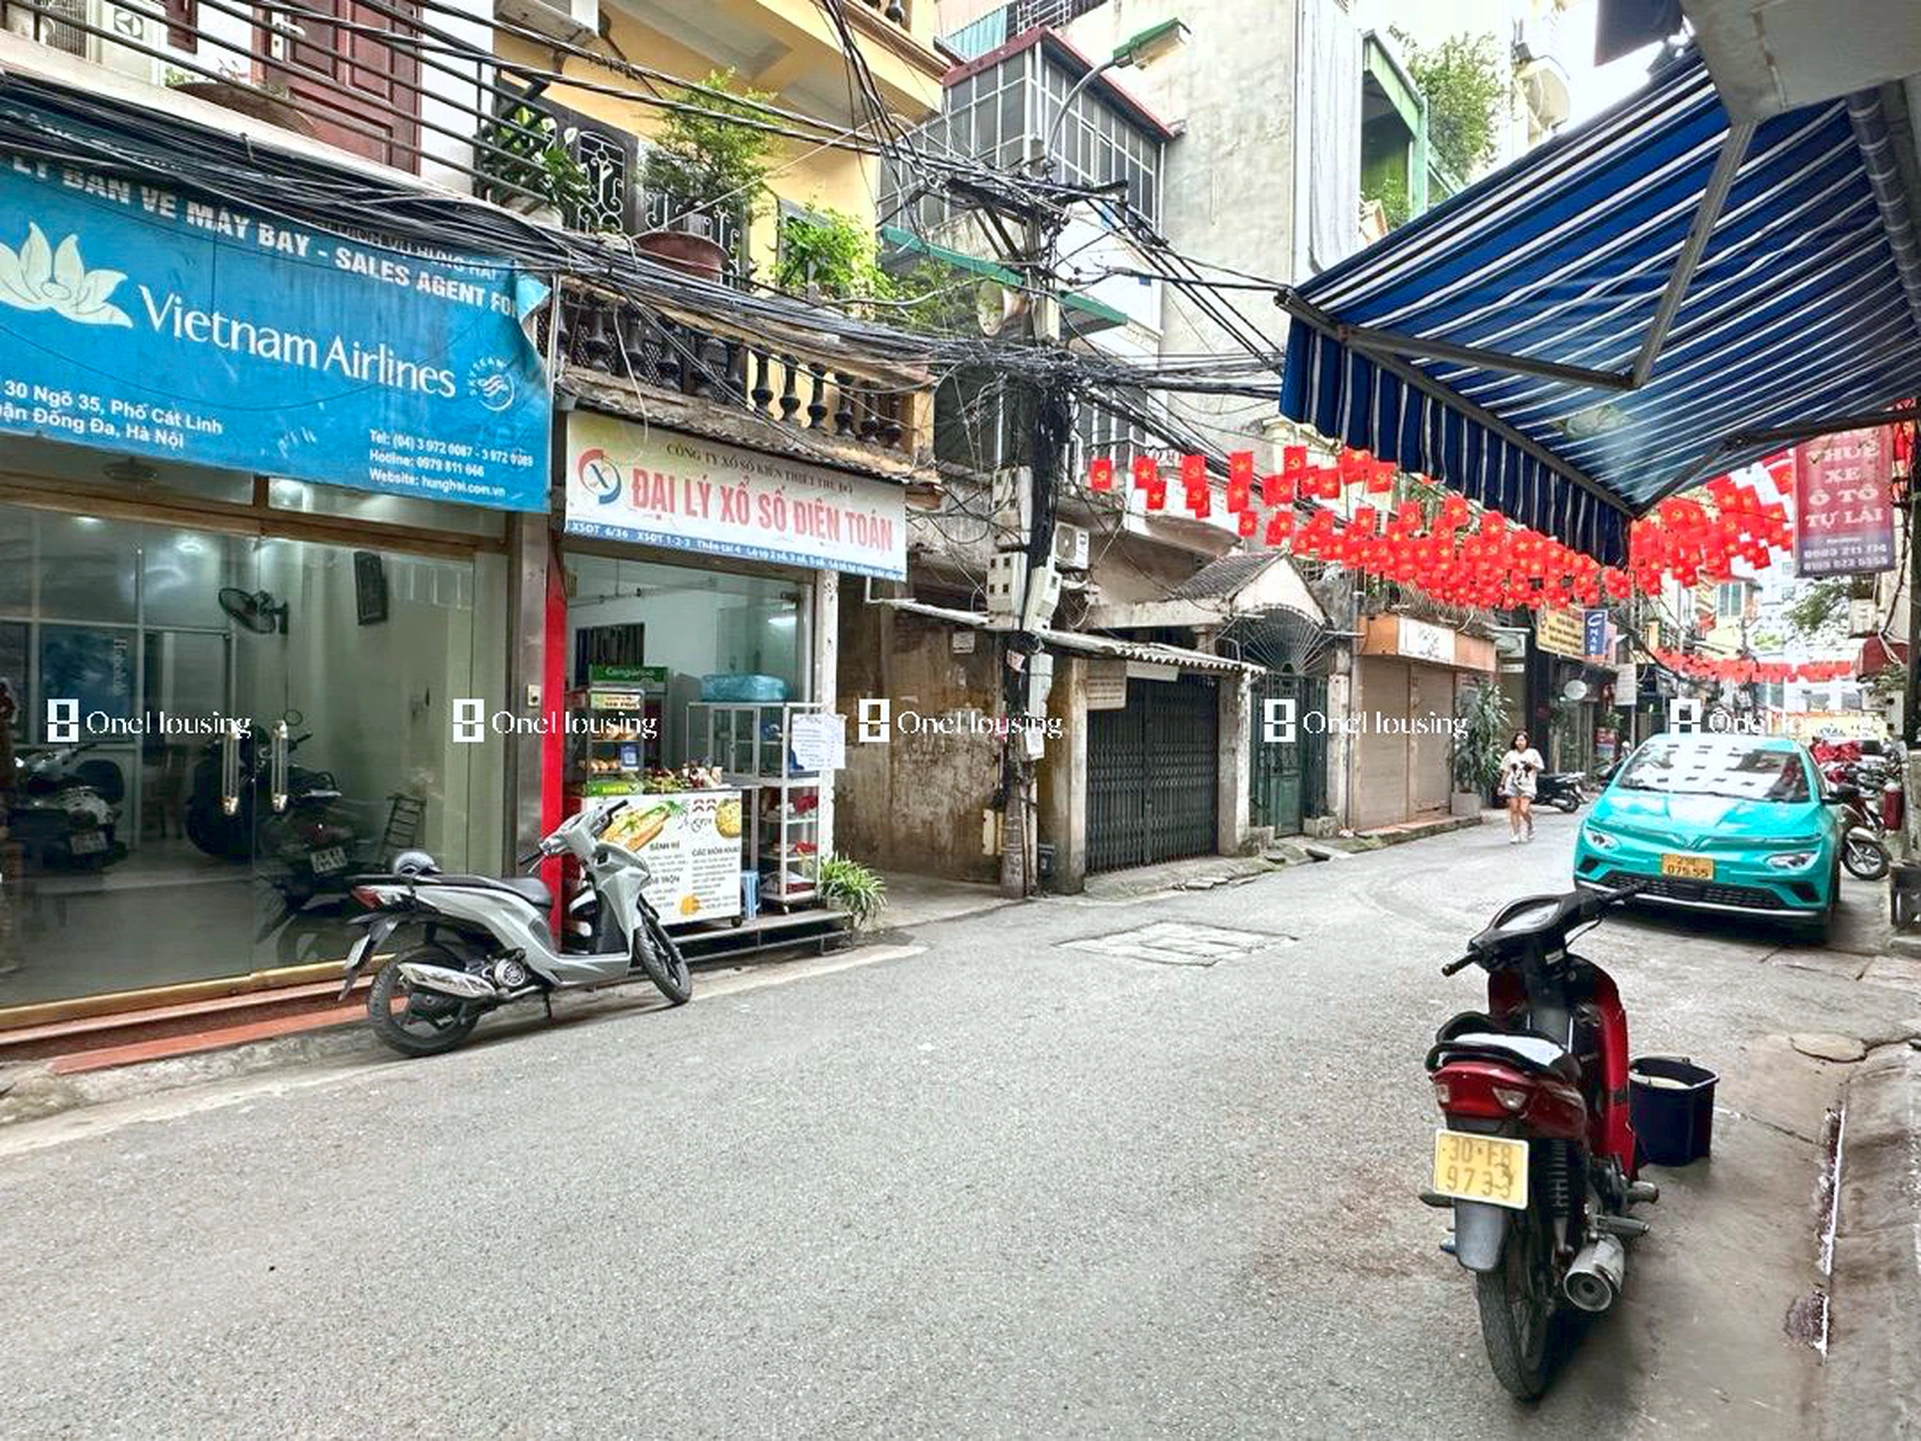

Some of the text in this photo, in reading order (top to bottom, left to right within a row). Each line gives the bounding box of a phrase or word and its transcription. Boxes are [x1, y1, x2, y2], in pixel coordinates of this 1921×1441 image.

[258, 223, 310, 258] BAY
[335, 246, 411, 287] SALES
[416, 271, 486, 307] AGENT
[138, 284, 456, 398] Vietnam Airlines
[4, 380, 223, 435] 30 Ngõ 35, Phố Cát Linh
[0, 402, 27, 423] ận
[91, 419, 120, 439] Đa,
[126, 422, 150, 442] Hà
[155, 430, 184, 451] Nội
[370, 429, 390, 445] Tel:
[392, 433, 415, 451] (04)
[417, 439, 425, 451] 3
[426, 440, 447, 455] 972
[666, 442, 699, 460] CÔNG
[704, 453, 718, 466] TY
[370, 449, 414, 467] Hotline:
[370, 467, 506, 498] Website: hunghai.com.vn
[1824, 467, 1861, 484] XE
[1808, 483, 1879, 506] Ô TÔ
[632, 467, 892, 552] ĐẠI LÝ XỔ SỐ ĐIỆN TOÁN
[1805, 504, 1884, 529] TỰ LÁI
[604, 526, 629, 539] 6/36
